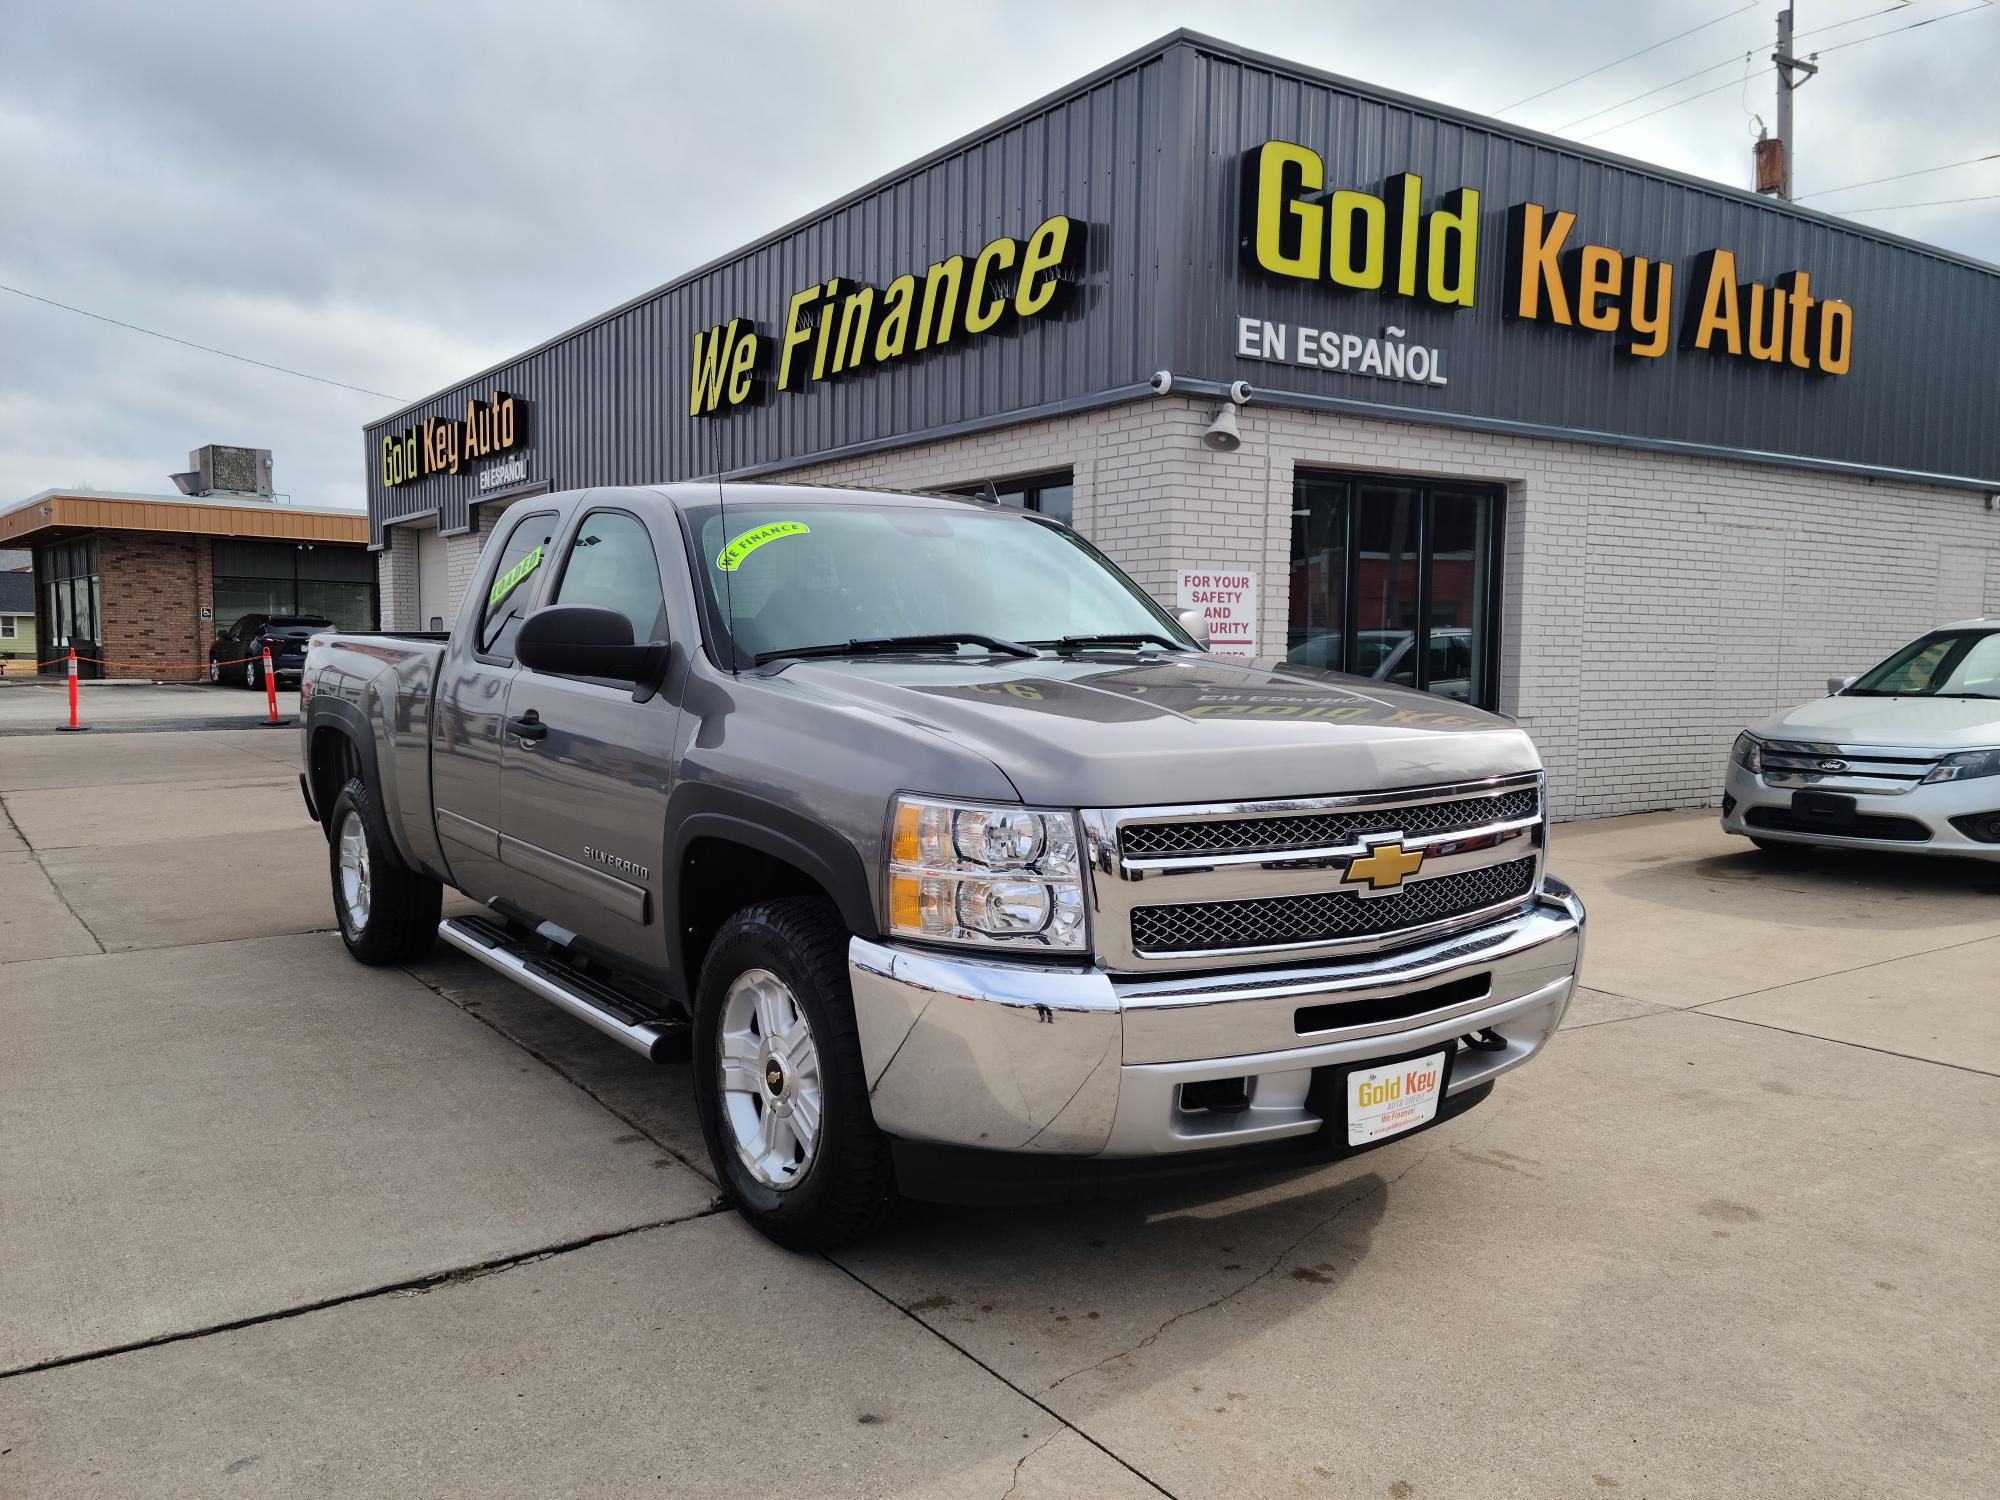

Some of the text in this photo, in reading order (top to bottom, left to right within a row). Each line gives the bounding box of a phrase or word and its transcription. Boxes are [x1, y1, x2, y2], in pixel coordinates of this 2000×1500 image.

[1256, 140, 1853, 376] Gold Key Auto
[690, 215, 1070, 416] We Finance
[1238, 317, 1447, 385] EN ESPAÑOL
[383, 390, 514, 487] Gold Key Auto
[480, 455, 527, 490] EN ESPAÑOL
[721, 524, 800, 566] WE FINANCE
[1184, 575, 1249, 588] FOR YOUR
[1192, 591, 1242, 603] SAFETY
[1204, 607, 1231, 618] AND
[1209, 622, 1249, 633] URITY
[584, 846, 649, 879] SILVERADO
[1359, 1070, 1437, 1107] Gold Key
[1381, 1113, 1391, 1123] We
